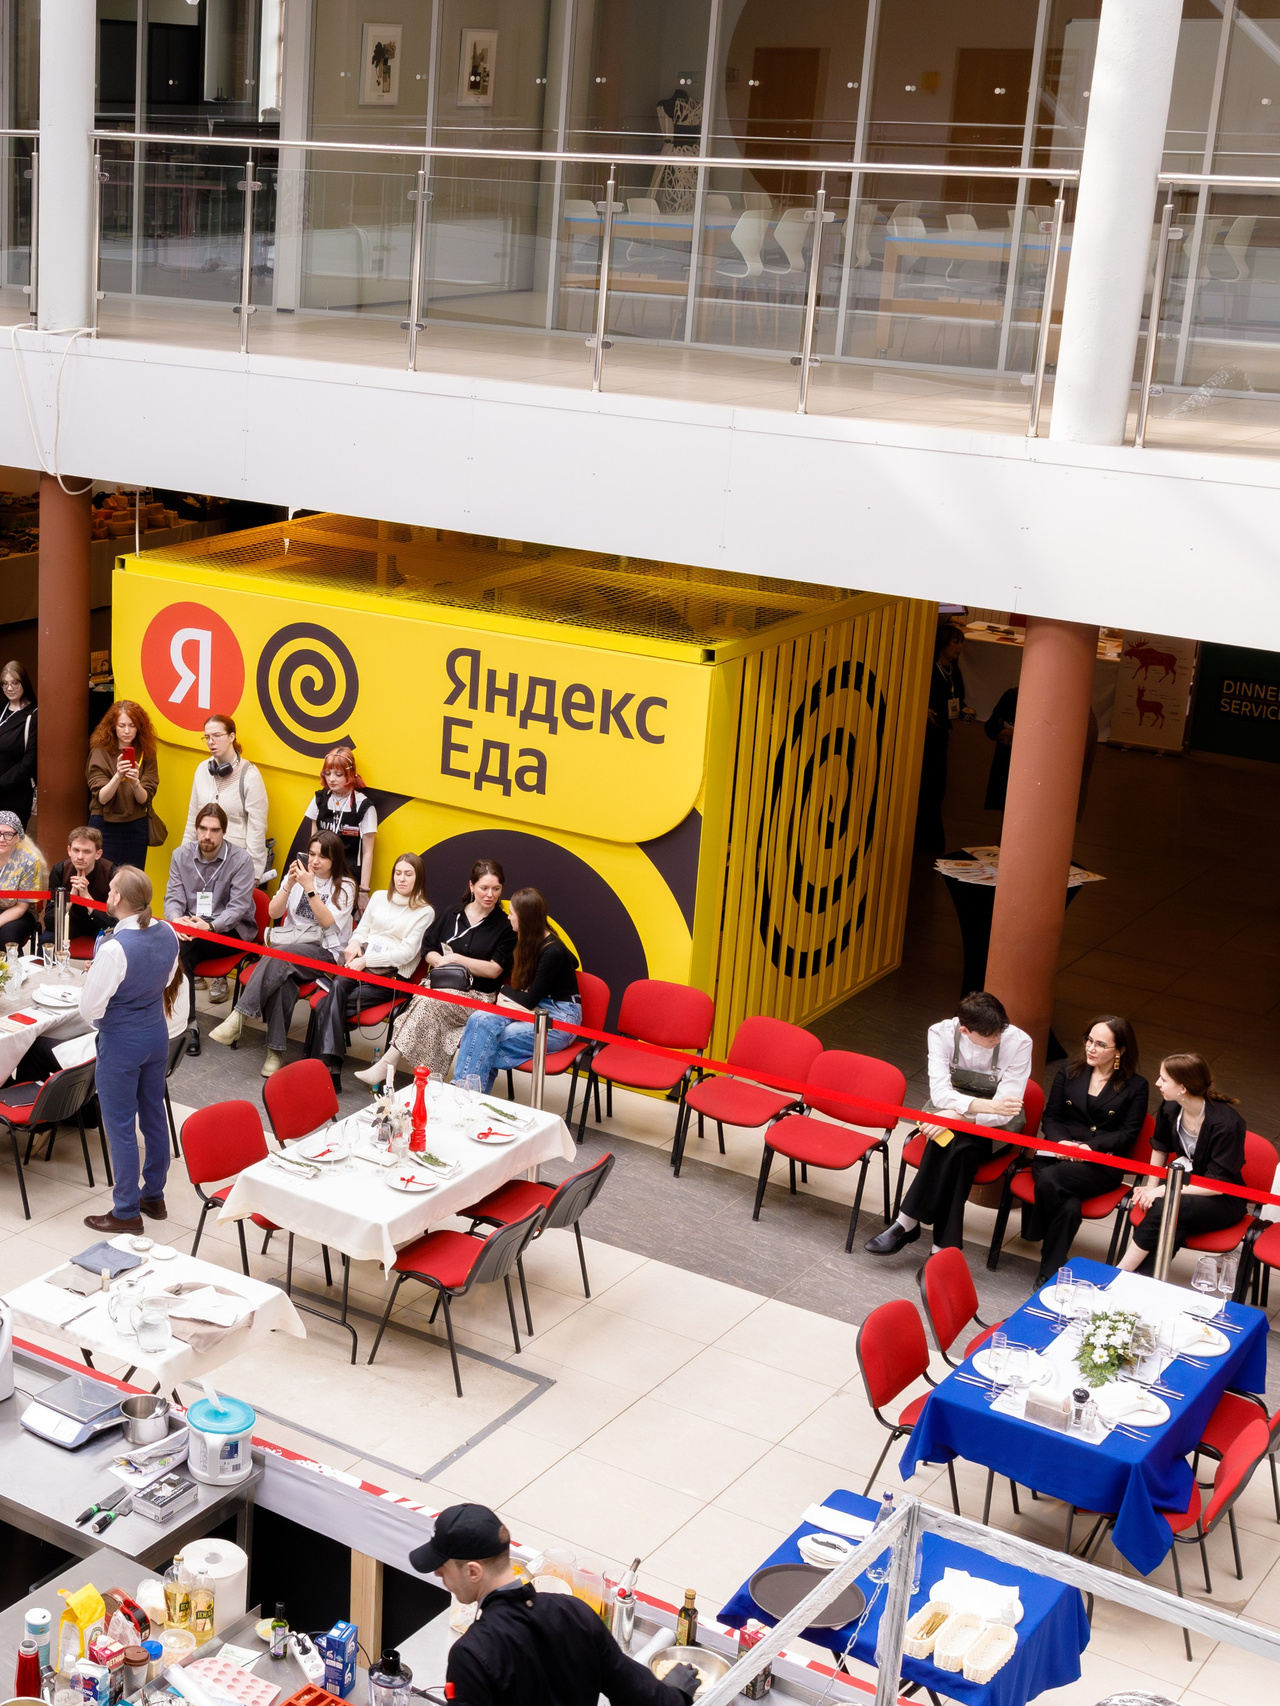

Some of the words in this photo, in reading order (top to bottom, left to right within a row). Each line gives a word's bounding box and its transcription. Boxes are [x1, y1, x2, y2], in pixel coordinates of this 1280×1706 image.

[168, 627, 212, 710] Я
[443, 647, 668, 745] Яндекс
[1220, 697, 1280, 721] SERVIC
[1222, 679, 1280, 701] DINNE
[440, 715, 548, 797] Еда
